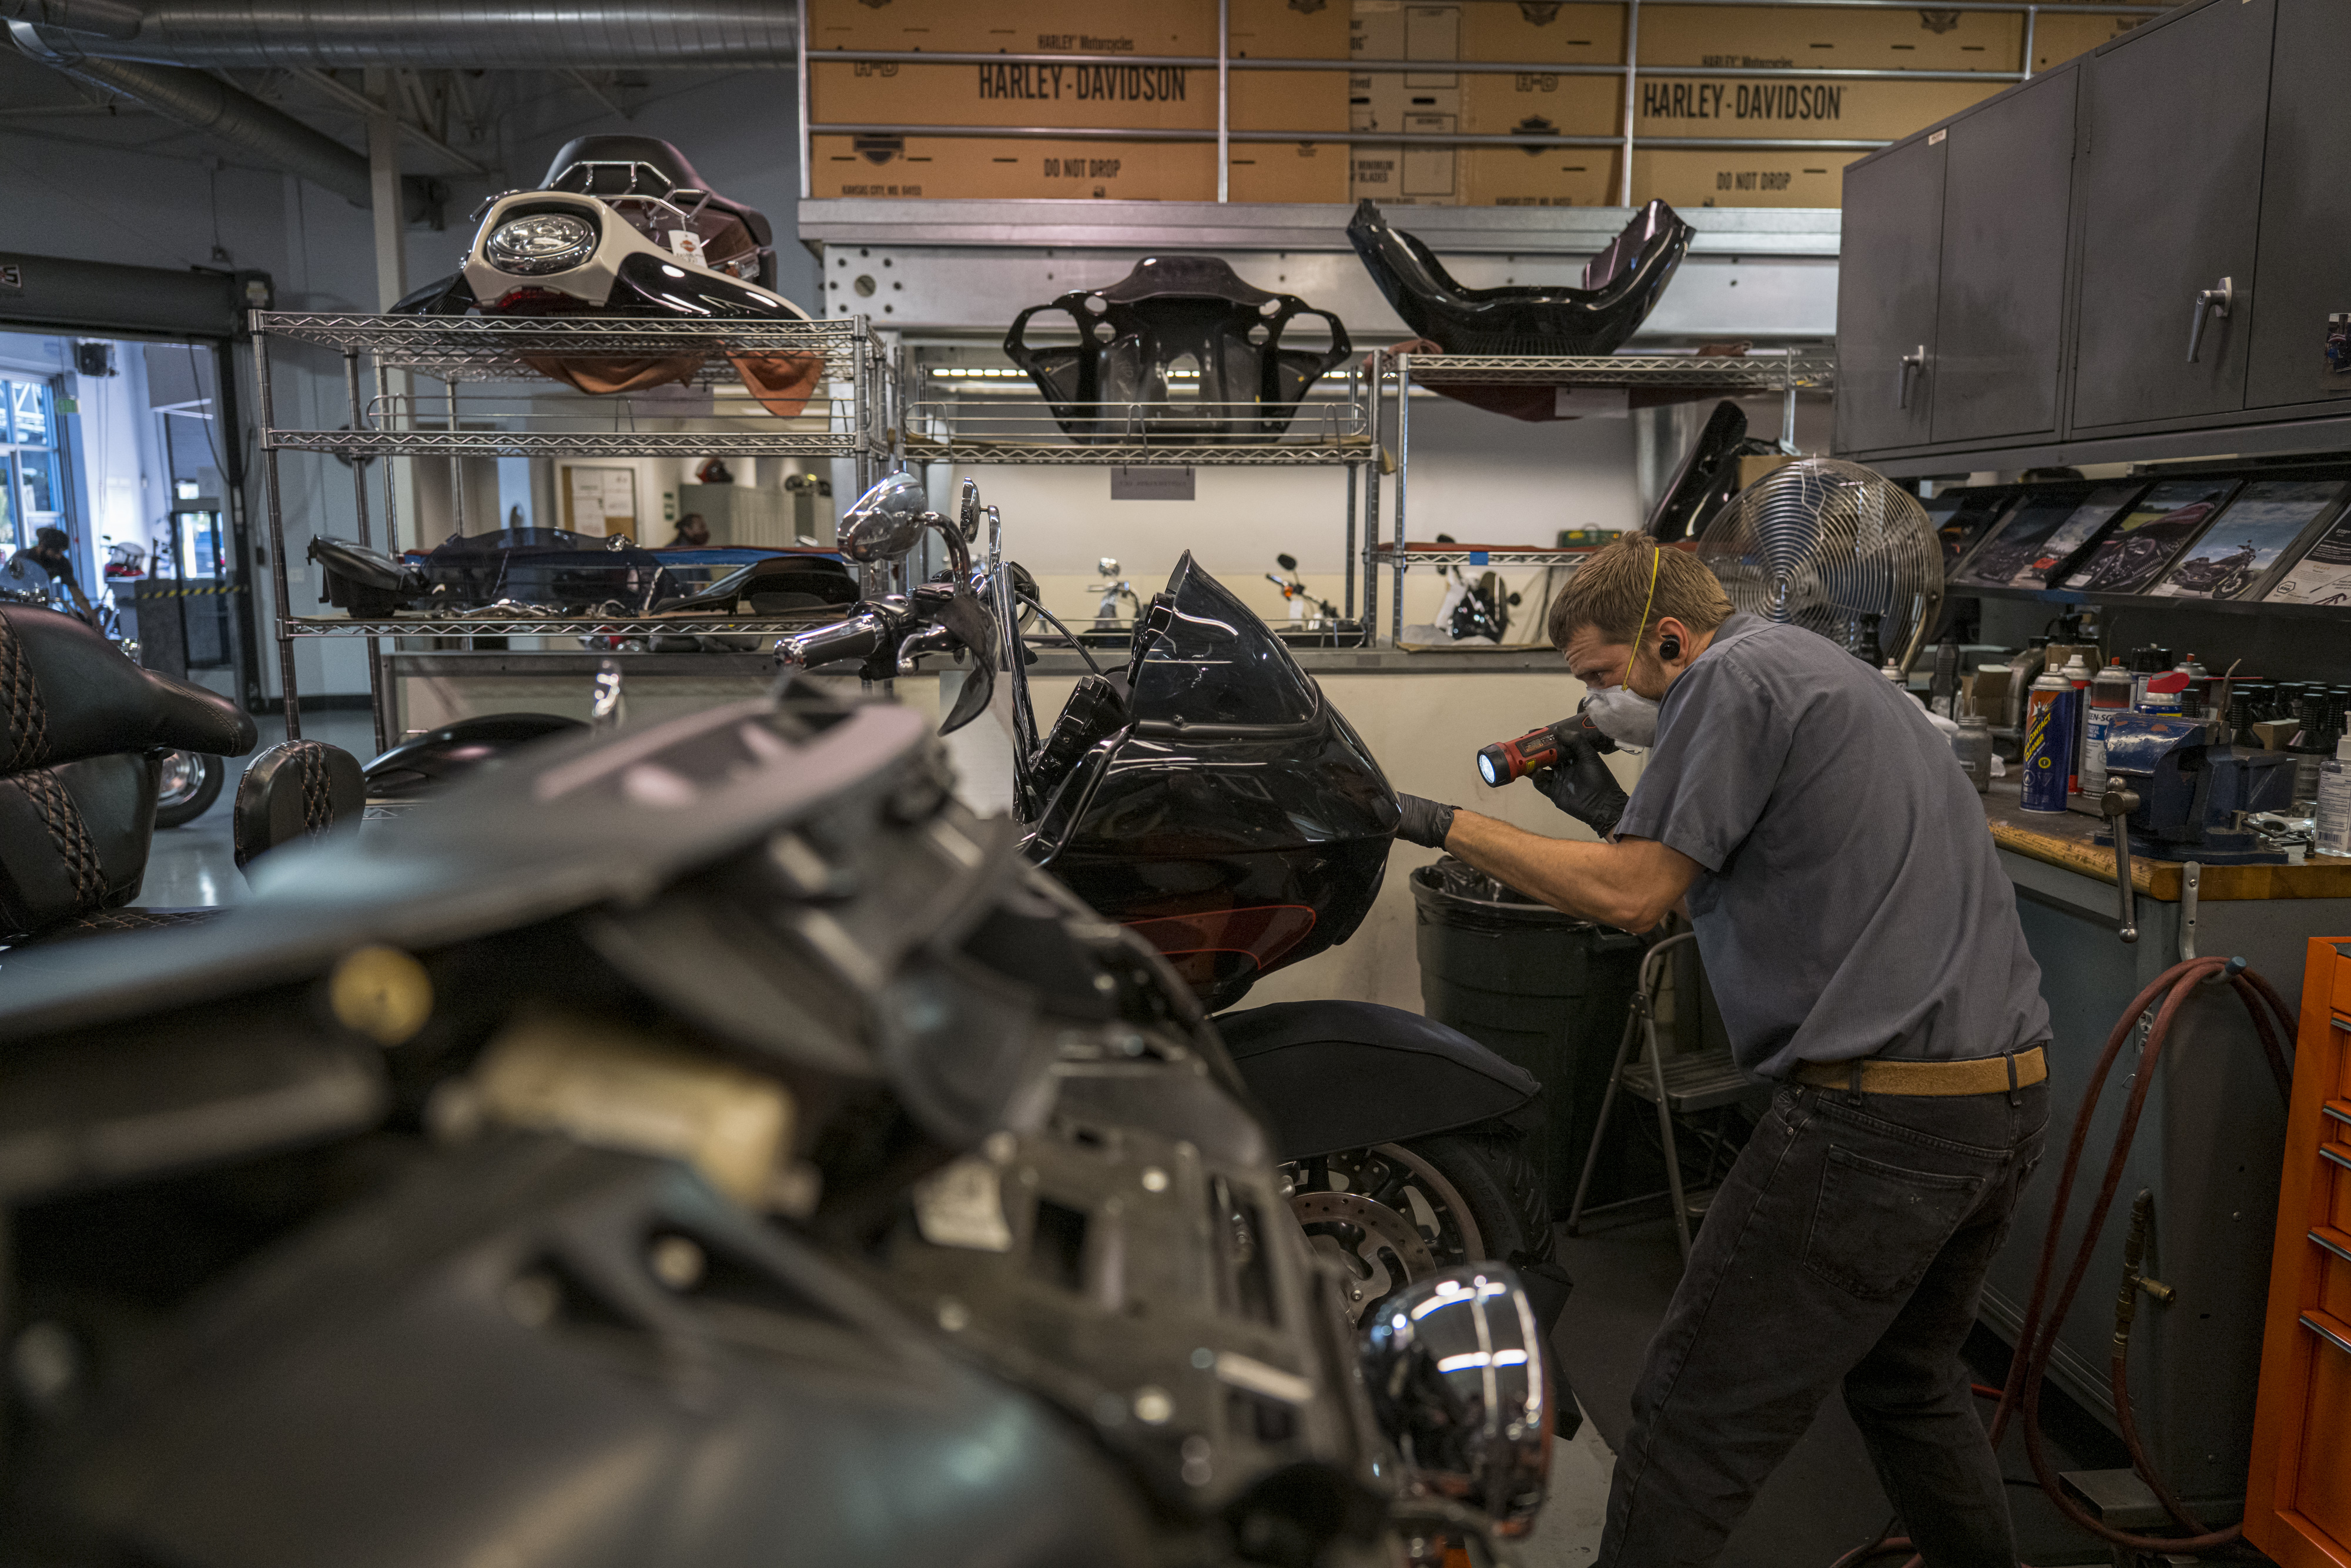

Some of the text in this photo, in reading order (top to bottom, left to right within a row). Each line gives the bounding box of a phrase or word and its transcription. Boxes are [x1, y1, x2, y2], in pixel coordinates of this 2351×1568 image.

[1044, 158, 1121, 178] DO NOT DROP
[1717, 172, 1791, 191] DO NOT DROP
[2029, 712, 2051, 744] CONTACT
[2025, 733, 2045, 762] CLEANER
